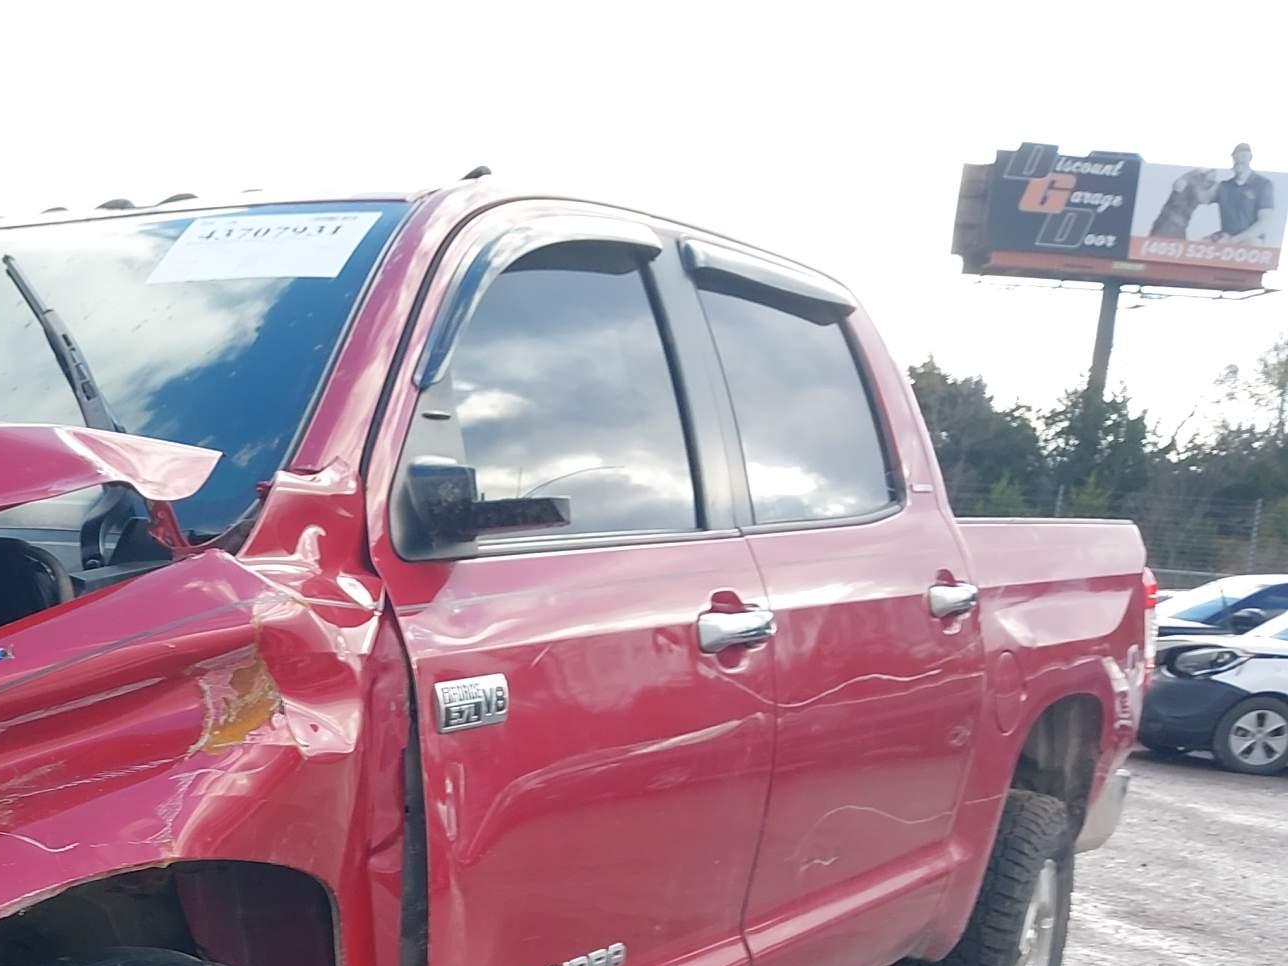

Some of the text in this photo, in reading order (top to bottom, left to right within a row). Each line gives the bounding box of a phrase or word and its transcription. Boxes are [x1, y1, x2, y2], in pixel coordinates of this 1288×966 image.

[1018, 172, 1123, 214] Garage
[1034, 207, 1118, 247] Door
[1141, 239, 1183, 258] (405)
[481, 686, 506, 714] V8
